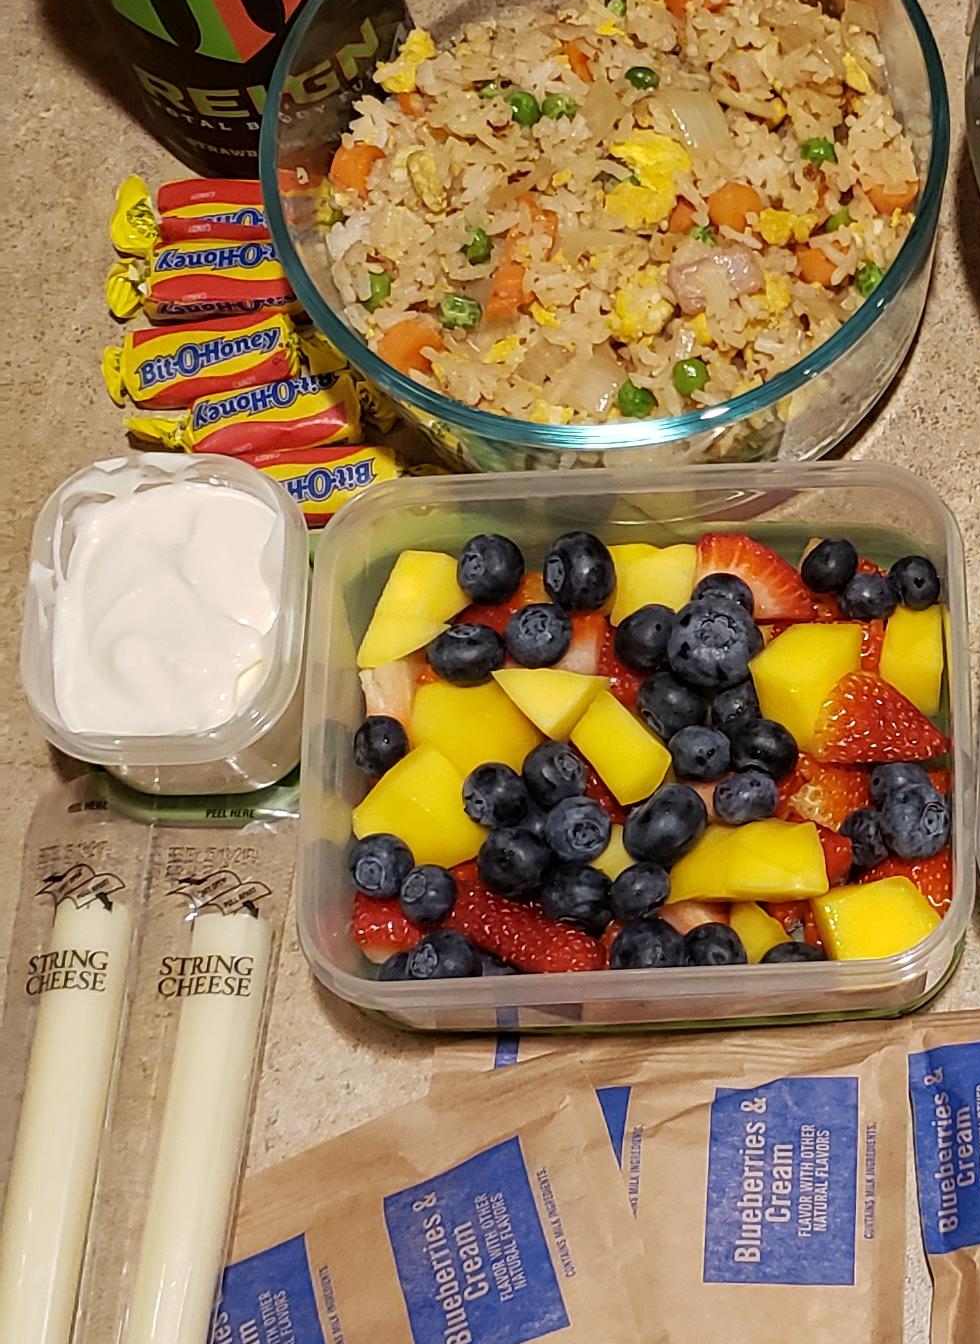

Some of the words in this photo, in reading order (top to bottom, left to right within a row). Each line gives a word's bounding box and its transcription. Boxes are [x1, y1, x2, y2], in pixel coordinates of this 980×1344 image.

[140, 329, 279, 387] Bit-O-Honey
[206, 809, 228, 819] PEEL
[230, 809, 255, 819] HERE
[28, 950, 109, 975] STRING
[160, 955, 254, 977] STRING
[26, 970, 107, 996] CHEESE
[158, 976, 251, 997] CHEESE
[924, 1067, 943, 1086] &
[741, 1096, 767, 1114] &
[801, 1125, 816, 1158] OTHER
[815, 1130, 830, 1177] FLAVORS
[956, 1106, 975, 1187] Cream
[800, 1162, 814, 1192] WITH
[932, 1092, 958, 1233] Blueberries
[413, 1191, 436, 1212] &
[734, 1122, 766, 1263] Blueberries
[765, 1144, 794, 1223] Cream
[474, 1193, 495, 1230] OTHER
[490, 1192, 514, 1240] FLAVORS
[798, 1191, 814, 1237] FLAVOR
[813, 1180, 829, 1232] NATURAL
[454, 1221, 490, 1301] Cream
[484, 1230, 500, 1259] WITH
[506, 1238, 527, 1290] NATURAL
[492, 1258, 514, 1301] FLAVOR
[258, 1290, 277, 1327] OTHER
[273, 1289, 294, 1336] FLAVORS
